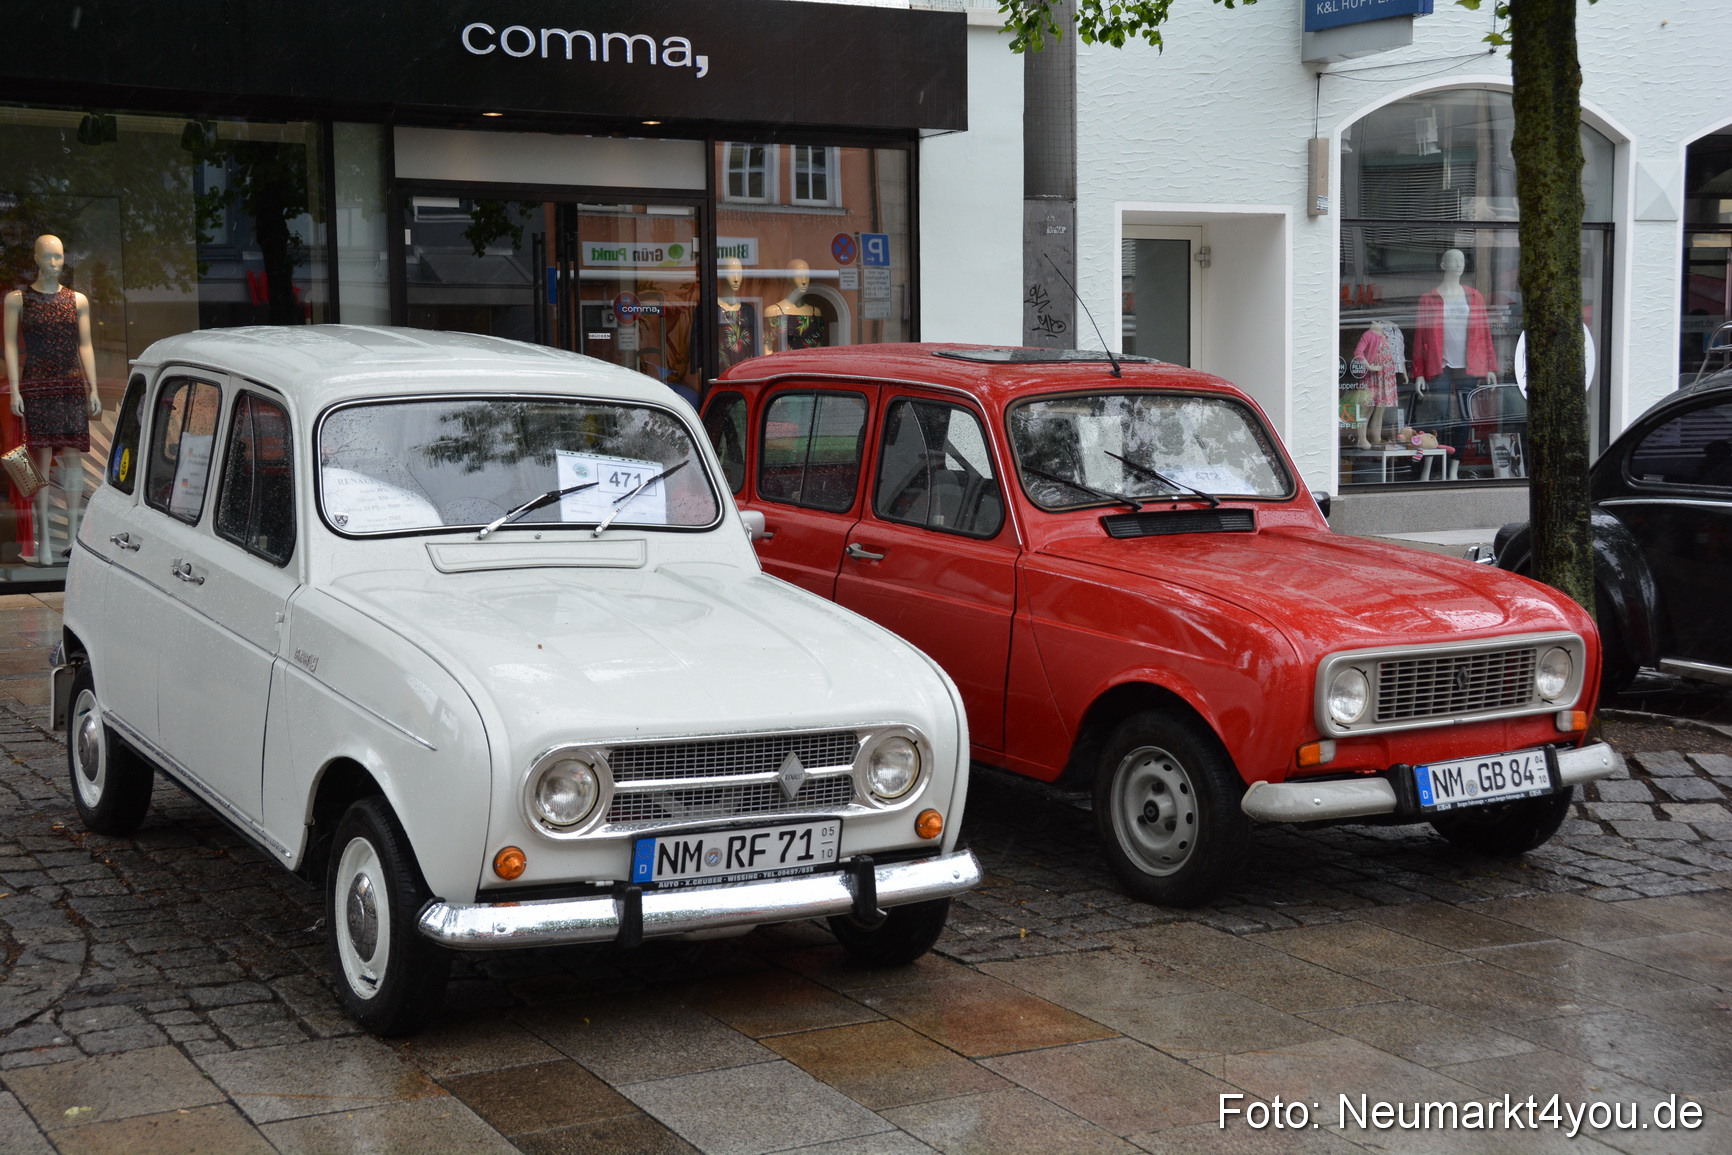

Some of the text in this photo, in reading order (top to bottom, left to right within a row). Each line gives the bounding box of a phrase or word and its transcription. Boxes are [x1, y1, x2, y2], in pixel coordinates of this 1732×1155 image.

[1316, 1, 1339, 15] K&L
[462, 22, 709, 78] comma,
[621, 306, 660, 314] comma,
[609, 471, 641, 487] 471
[1431, 755, 1544, 800] NM GB 84 04
[1538, 774, 1547, 784] 10
[1422, 790, 1429, 800] D
[657, 825, 835, 876] NM RF 71 05
[821, 849, 834, 860] 10
[639, 864, 647, 875] D
[658, 881, 679, 889] AUTO
[727, 873, 758, 883] WISSING
